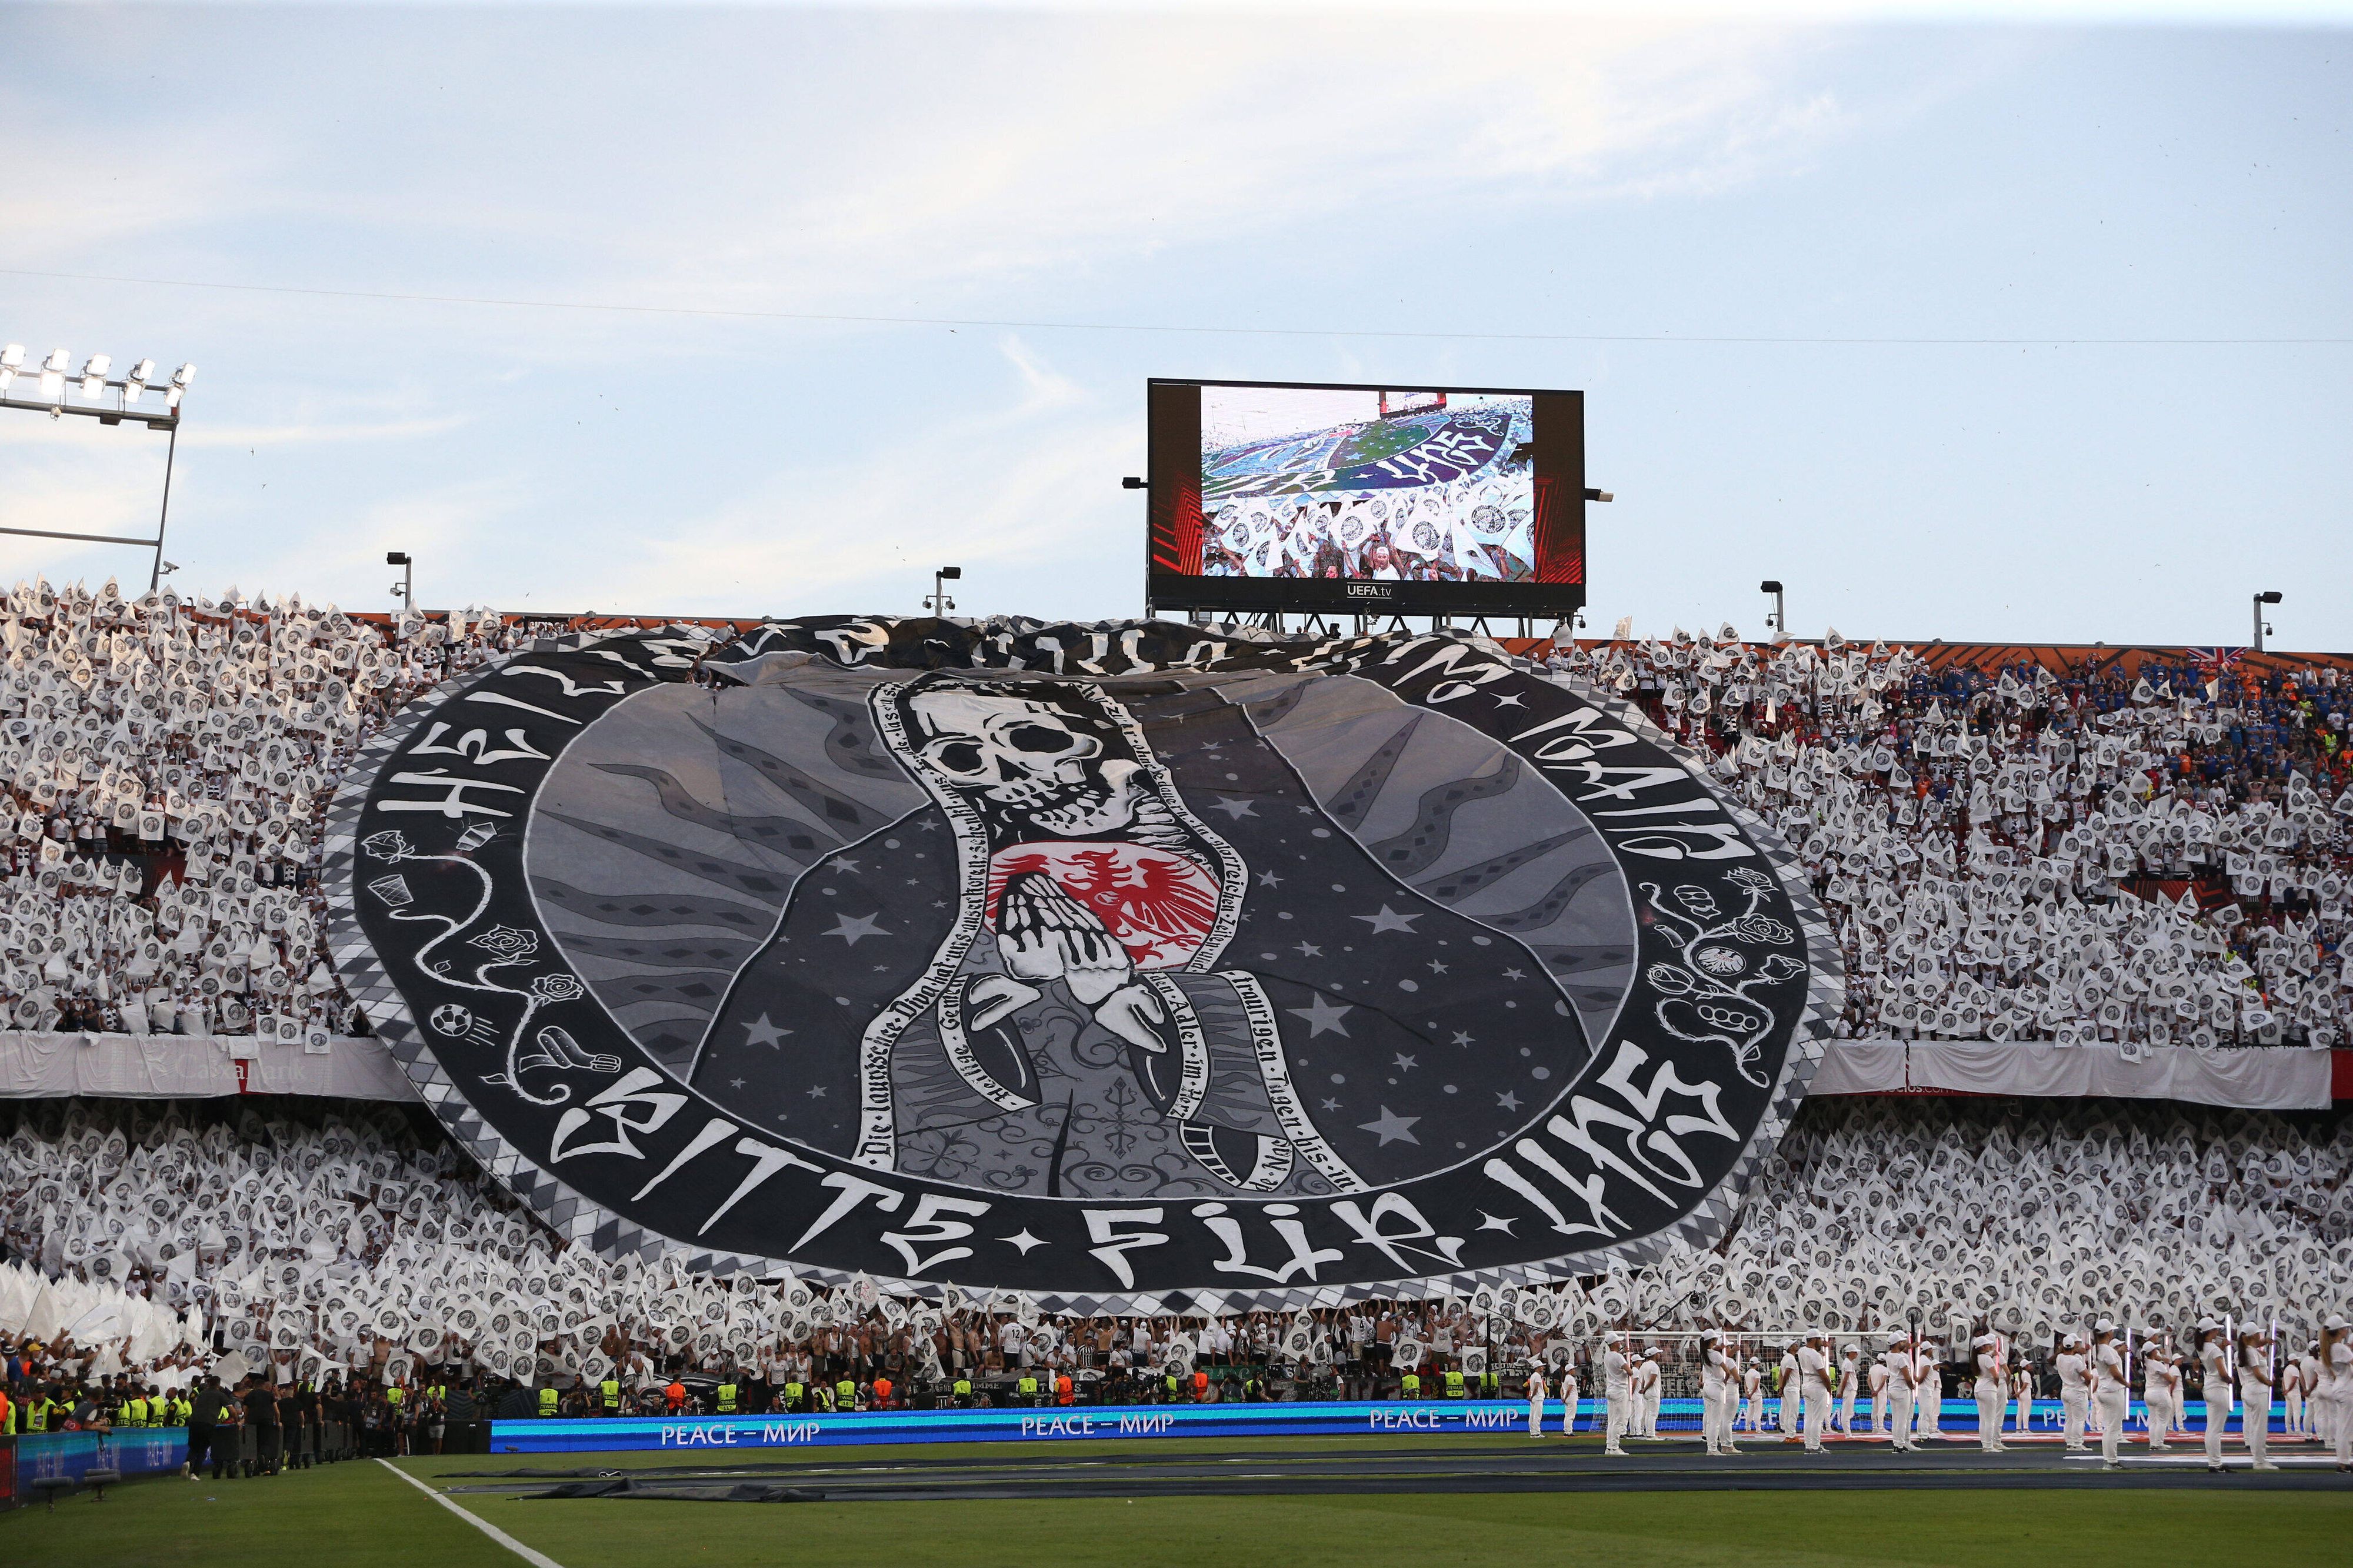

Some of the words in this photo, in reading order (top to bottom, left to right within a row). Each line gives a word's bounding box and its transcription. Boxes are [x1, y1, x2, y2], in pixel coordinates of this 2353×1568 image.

[1347, 585, 1391, 596] UEFA.tv
[886, 982, 939, 1019] Diva
[1170, 1000, 1199, 1054] Adler
[1184, 1060, 1203, 1080] im
[1232, 977, 1277, 1062] traurigen
[1293, 1135, 1328, 1163] bis
[550, 1066, 991, 1276] BITTE
[1082, 1192, 1465, 1289] FÜR
[1483, 1039, 1740, 1239] UNS
[1012, 1329, 1020, 1339] 12
[1022, 1416, 1095, 1436] PEACE
[1371, 1409, 1441, 1428] PEACE
[662, 1424, 737, 1445] PEACE
